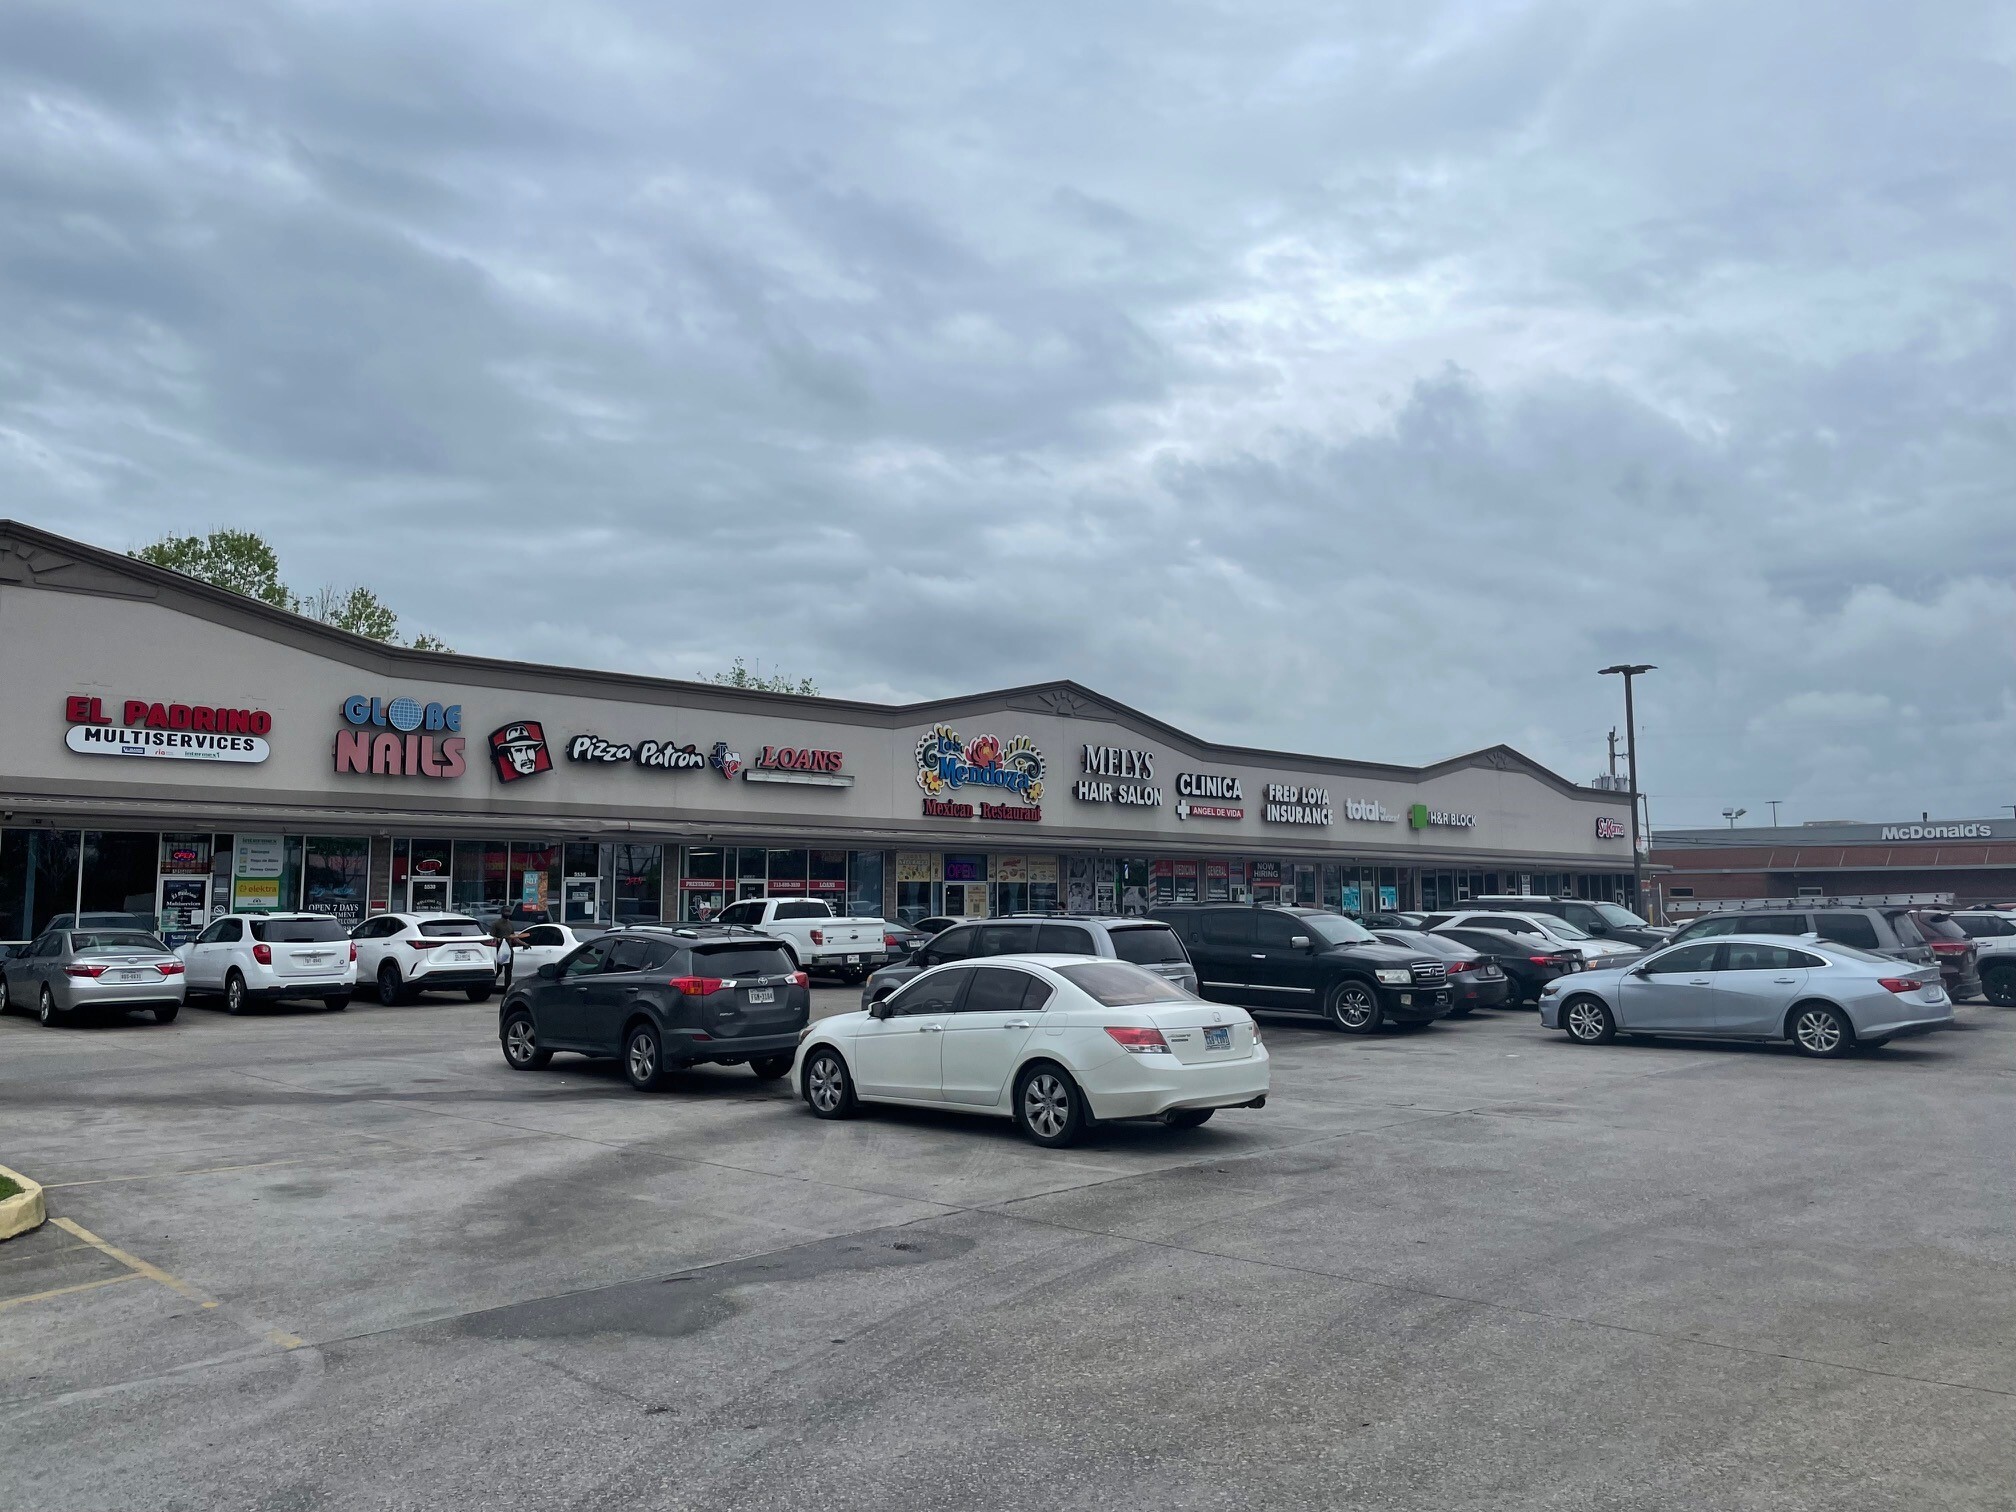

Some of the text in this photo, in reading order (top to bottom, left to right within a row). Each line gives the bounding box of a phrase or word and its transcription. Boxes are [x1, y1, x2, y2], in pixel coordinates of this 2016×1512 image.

[66, 696, 272, 735] EL PADRINO
[345, 695, 461, 732] GLOBE
[85, 728, 254, 751] MULTISERVICES
[572, 736, 631, 761] Pizza
[937, 736, 965, 756] Los
[335, 729, 466, 777] NAILS
[759, 745, 843, 772] LOANS
[1083, 744, 1155, 781] MELYS
[938, 756, 1031, 792] Mendoza
[1077, 780, 1164, 806] HAIR SALON
[1178, 773, 1244, 800] CLINICA
[1268, 784, 1330, 805] FRED LOYA
[923, 798, 1041, 821] Mexican Restaurant
[1193, 806, 1242, 818] ANGEL DE VIDA
[1266, 804, 1335, 825] INSURANCE
[1345, 798, 1379, 821] total
[1430, 811, 1477, 827] H&R BLOCK
[1881, 824, 1992, 840] McDonald's
[173, 851, 197, 860] OPEN
[1257, 862, 1275, 870] NOW
[949, 864, 976, 878] OPEN
[1207, 865, 1227, 876] GENERAL
[1253, 870, 1279, 878] HIRING
[248, 885, 277, 893] elektra
